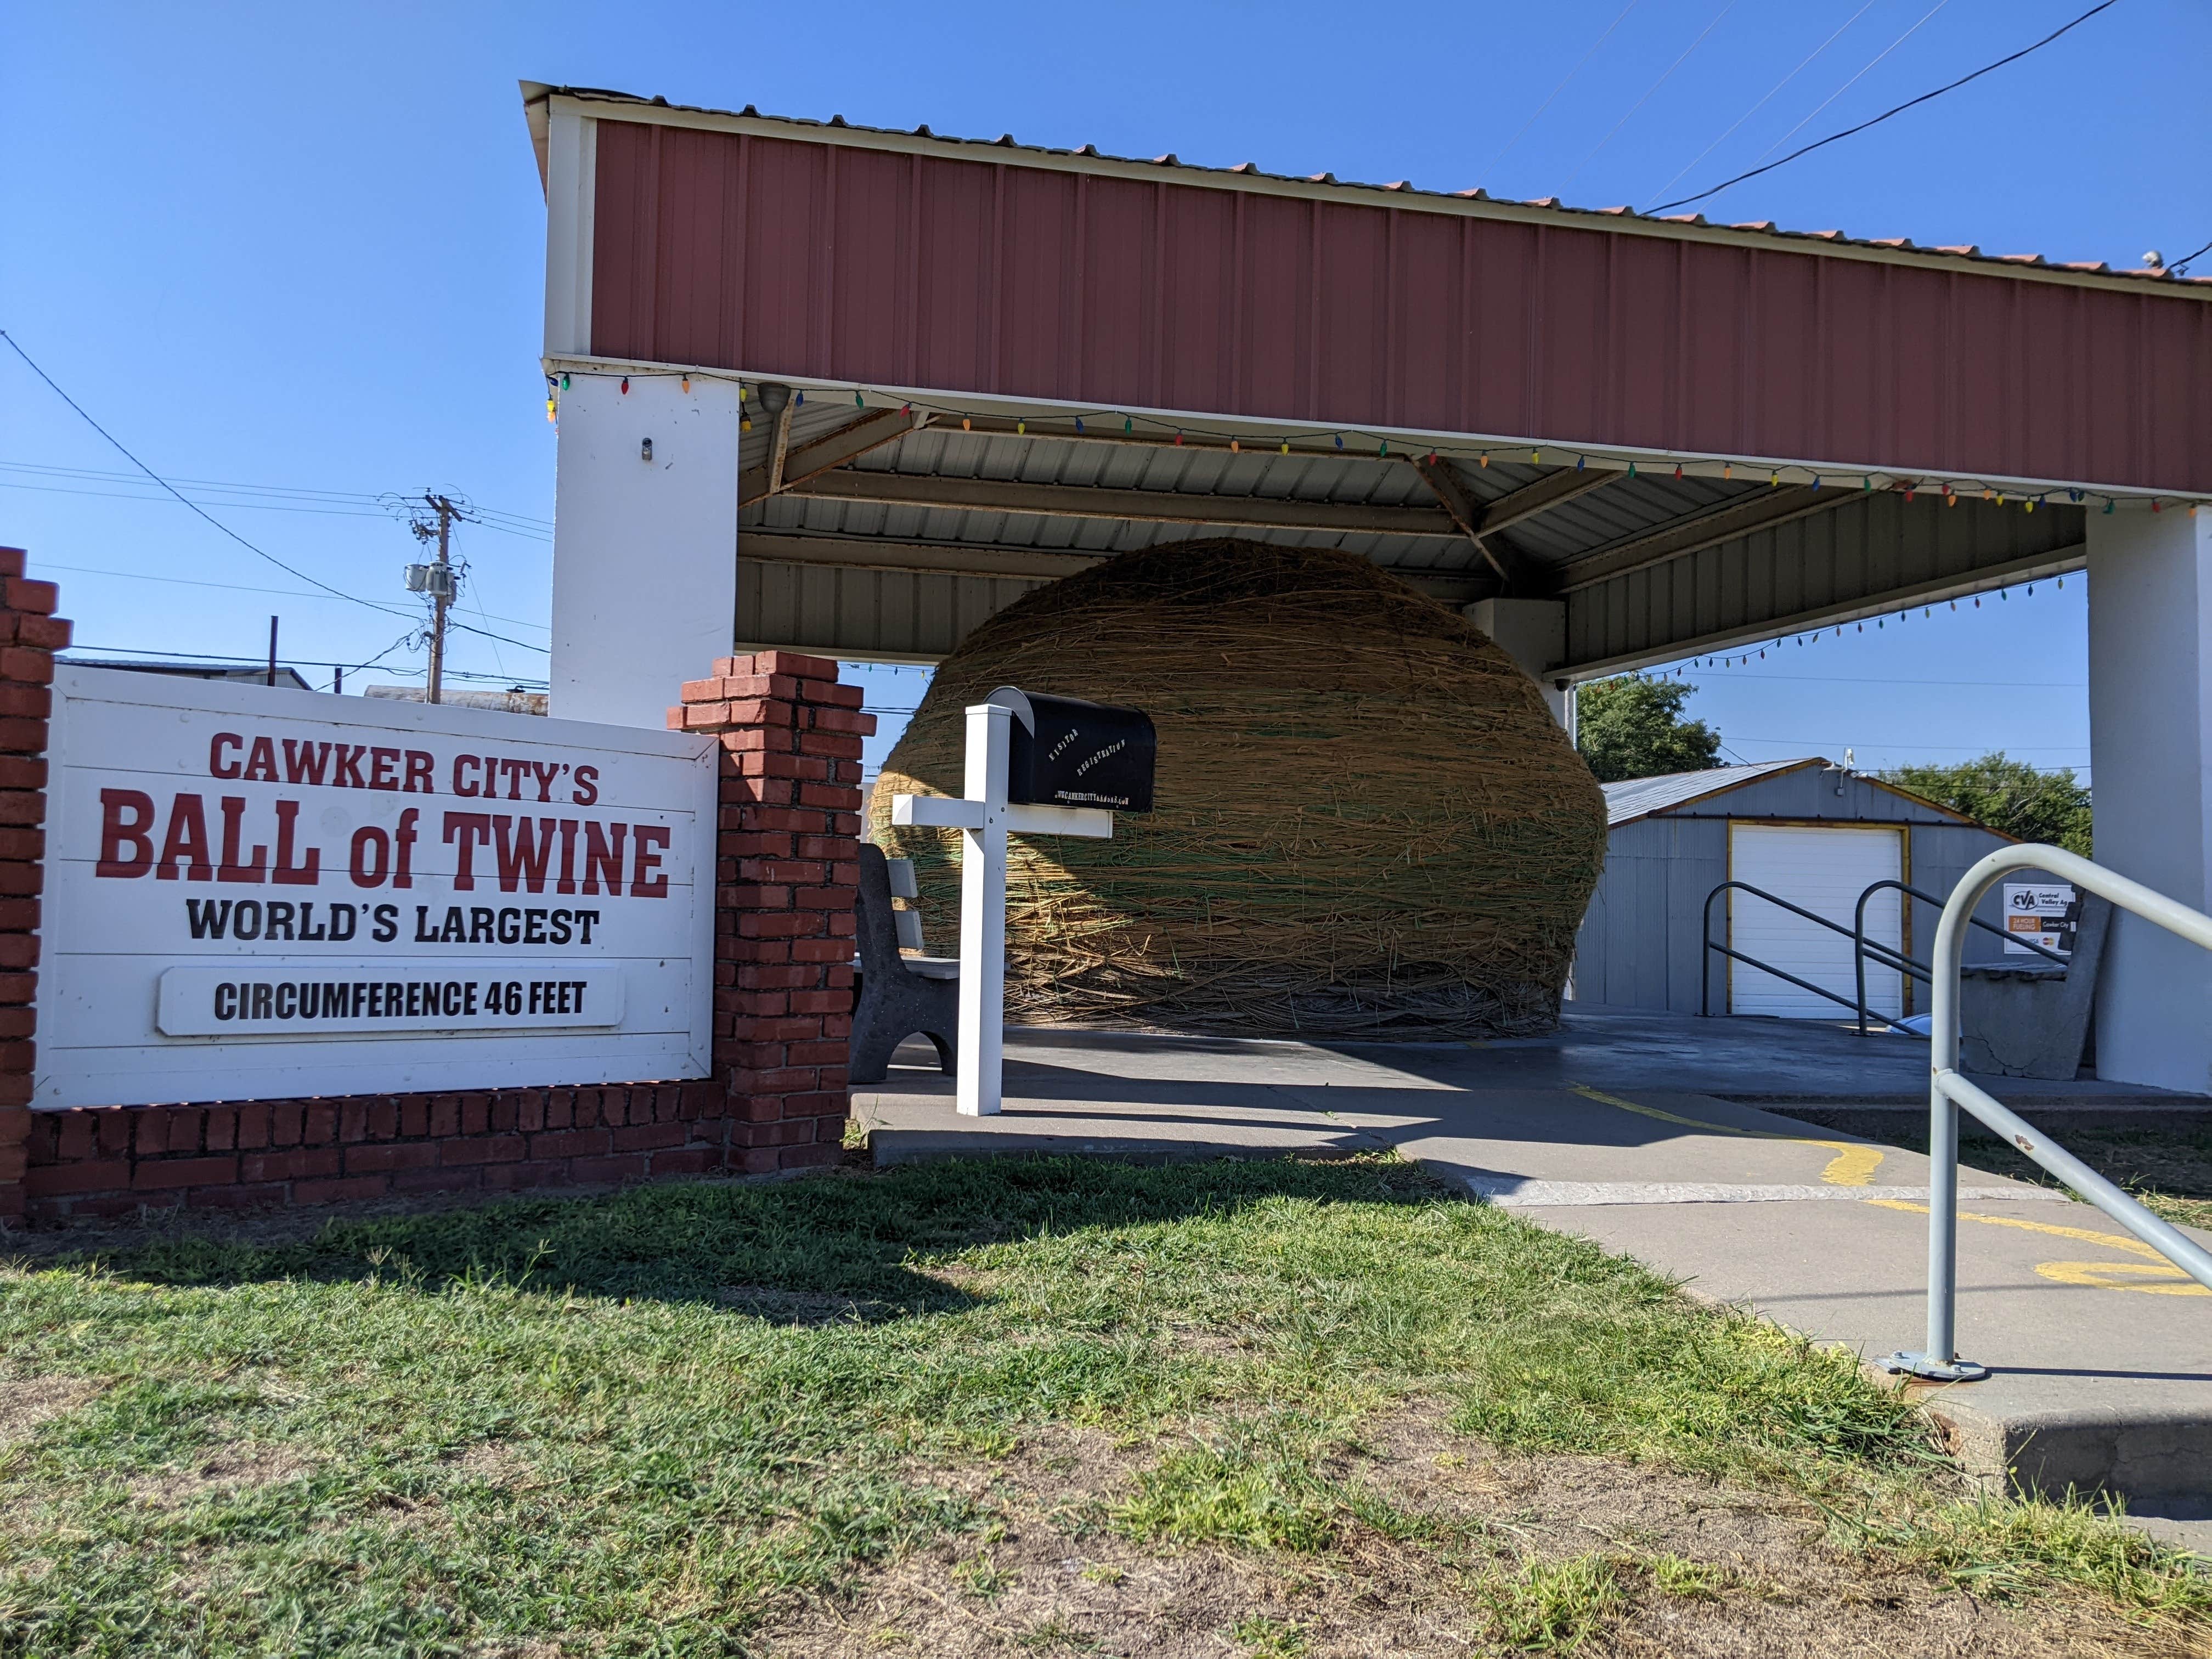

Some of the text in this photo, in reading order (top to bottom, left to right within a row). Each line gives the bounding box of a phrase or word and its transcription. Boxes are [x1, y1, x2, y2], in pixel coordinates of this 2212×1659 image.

[1048, 729, 1079, 761] VISITOR
[210, 732, 599, 806] CAWKER CITY'S
[95, 788, 671, 899] BALL of TWINE
[2013, 890, 2035, 909] CVA
[186, 899, 600, 945] WORLD'S LARGEST
[215, 980, 588, 1021] CIRCUMFERENCE 46 FEET
